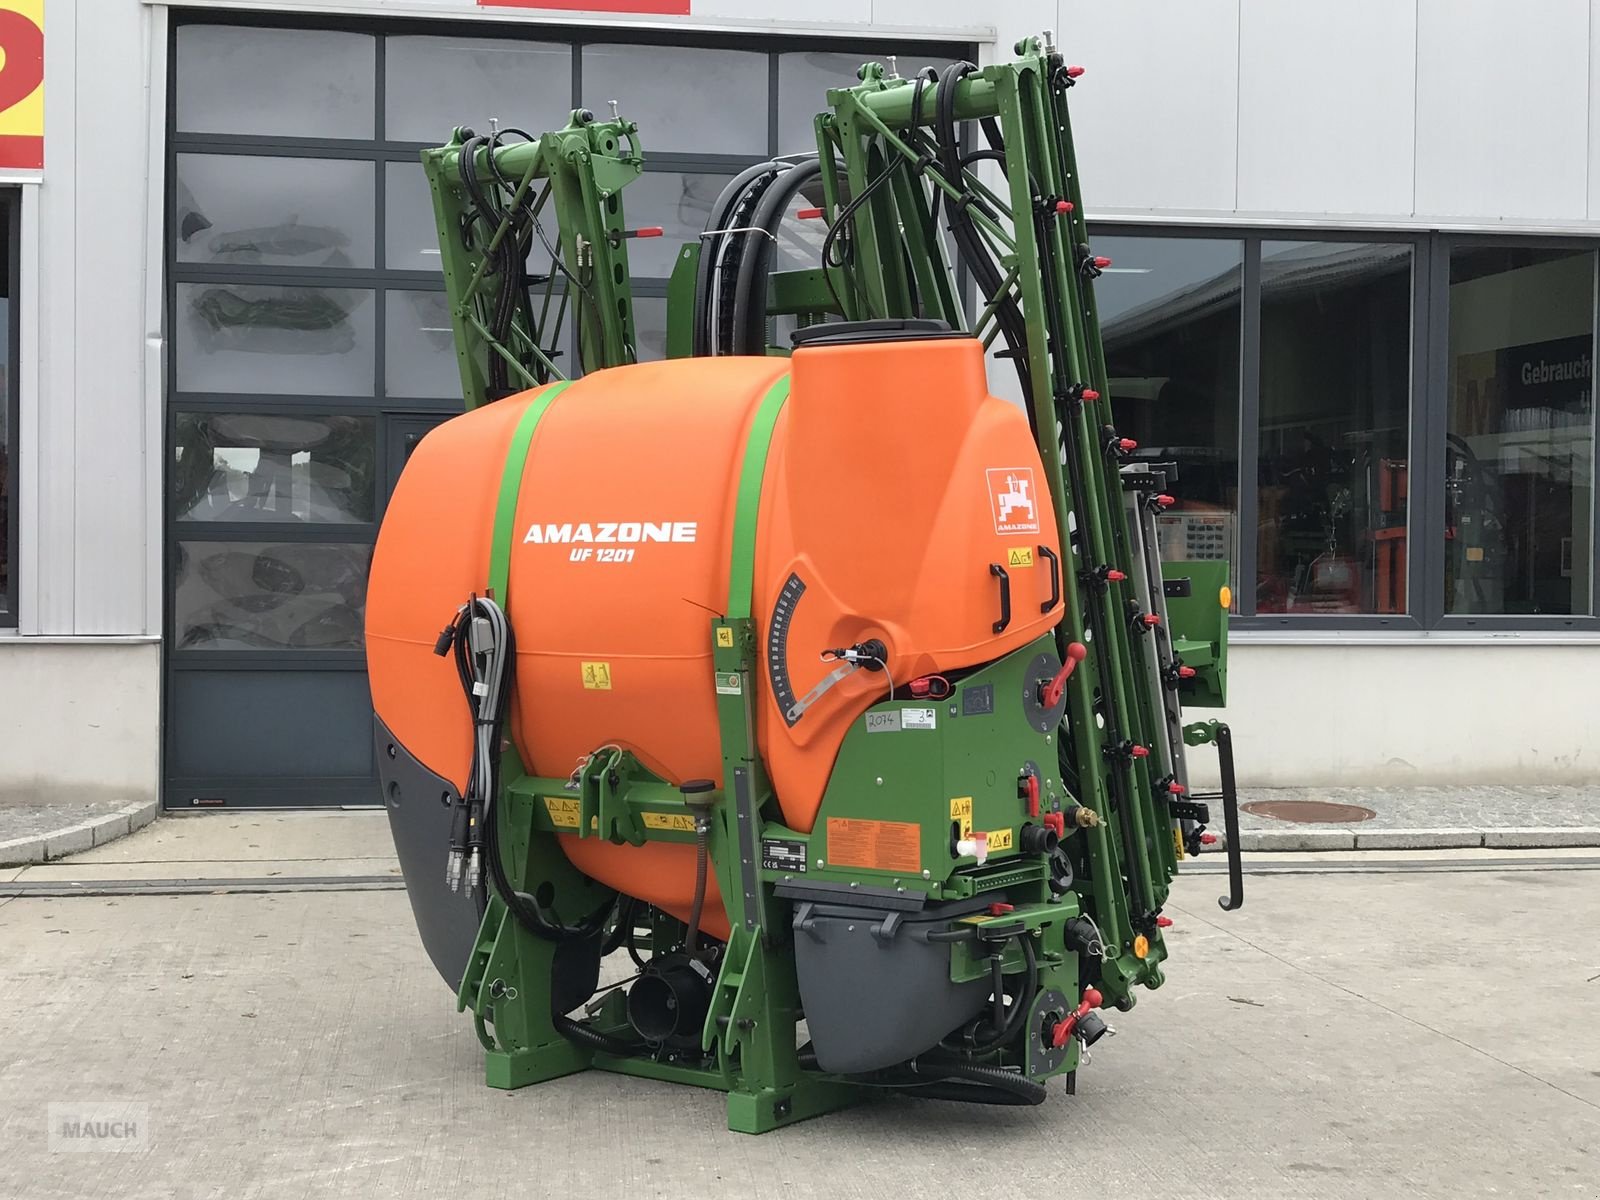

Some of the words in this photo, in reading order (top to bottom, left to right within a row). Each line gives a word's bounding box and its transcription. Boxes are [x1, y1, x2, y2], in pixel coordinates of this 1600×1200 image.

[523, 522, 697, 543] AMAZONE
[998, 523, 1038, 531] AMAZONE
[569, 548, 593, 562] UF
[596, 549, 635, 562] 1201
